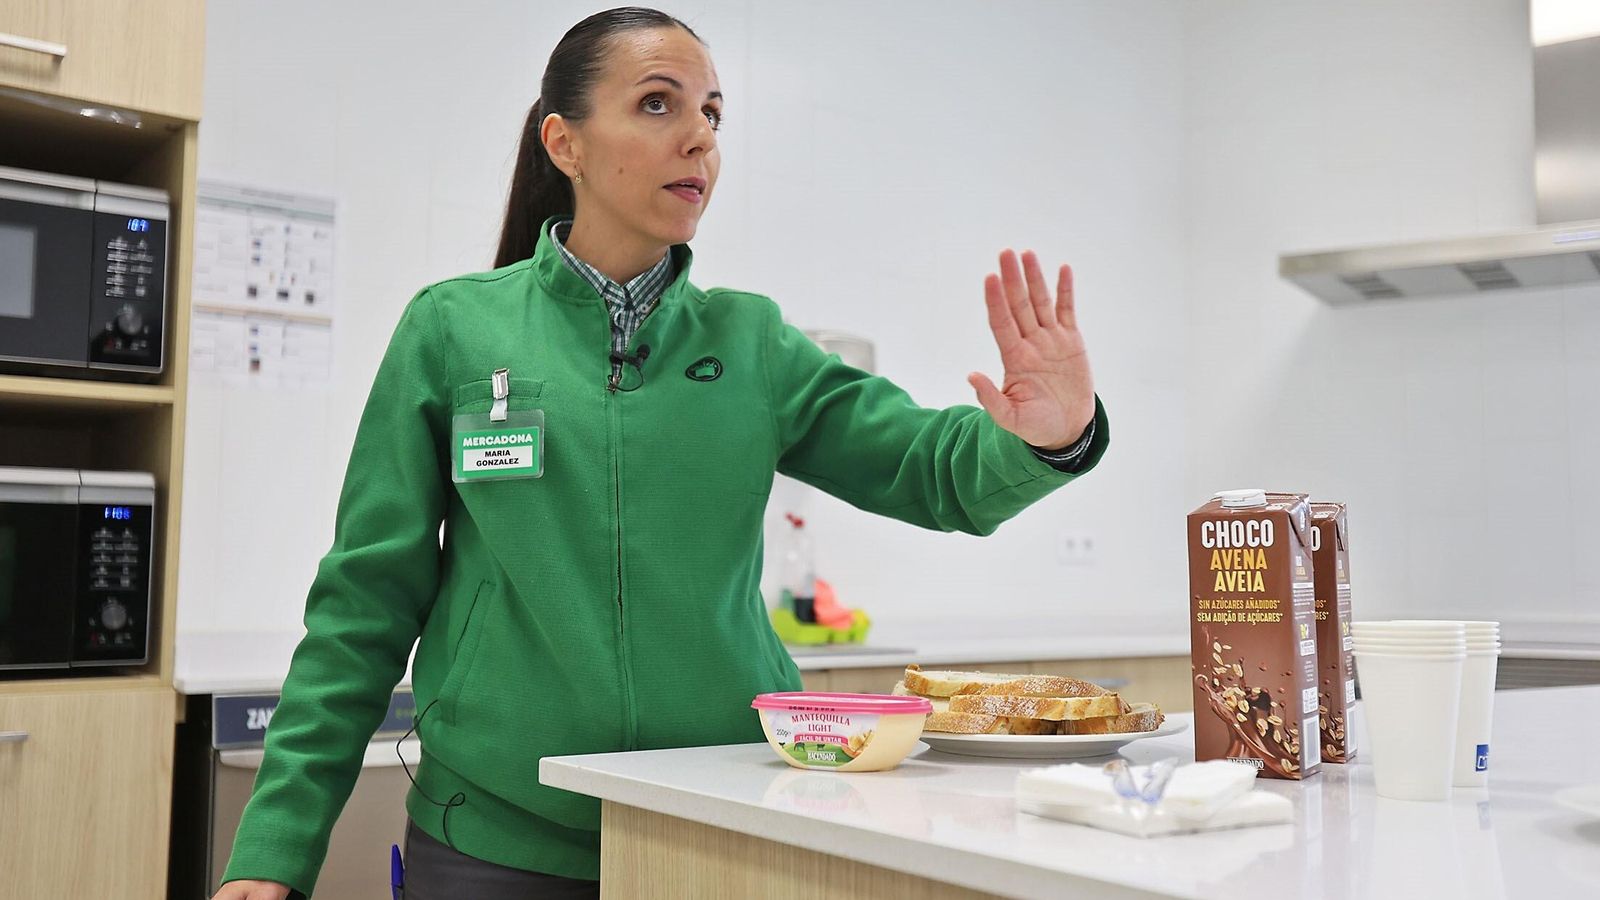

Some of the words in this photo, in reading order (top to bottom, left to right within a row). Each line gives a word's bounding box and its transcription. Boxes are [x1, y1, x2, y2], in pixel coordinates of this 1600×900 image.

[463, 433, 533, 447] MERCADONA
[484, 449, 511, 457] MARIA
[476, 457, 519, 467] GONZALEZ
[1201, 519, 1274, 549] CHOCO
[1210, 548, 1268, 571] AVENA
[1214, 570, 1266, 593] AVEIA
[1198, 600, 1211, 610] SIN
[1211, 597, 1244, 610] AZÚCARES
[1197, 613, 1212, 622] SEM
[1212, 610, 1237, 626] ADIÇÃO
[1237, 613, 1247, 622] DE
[791, 713, 850, 726] MANTEQUILLA
[808, 724, 832, 733] LIGHT
